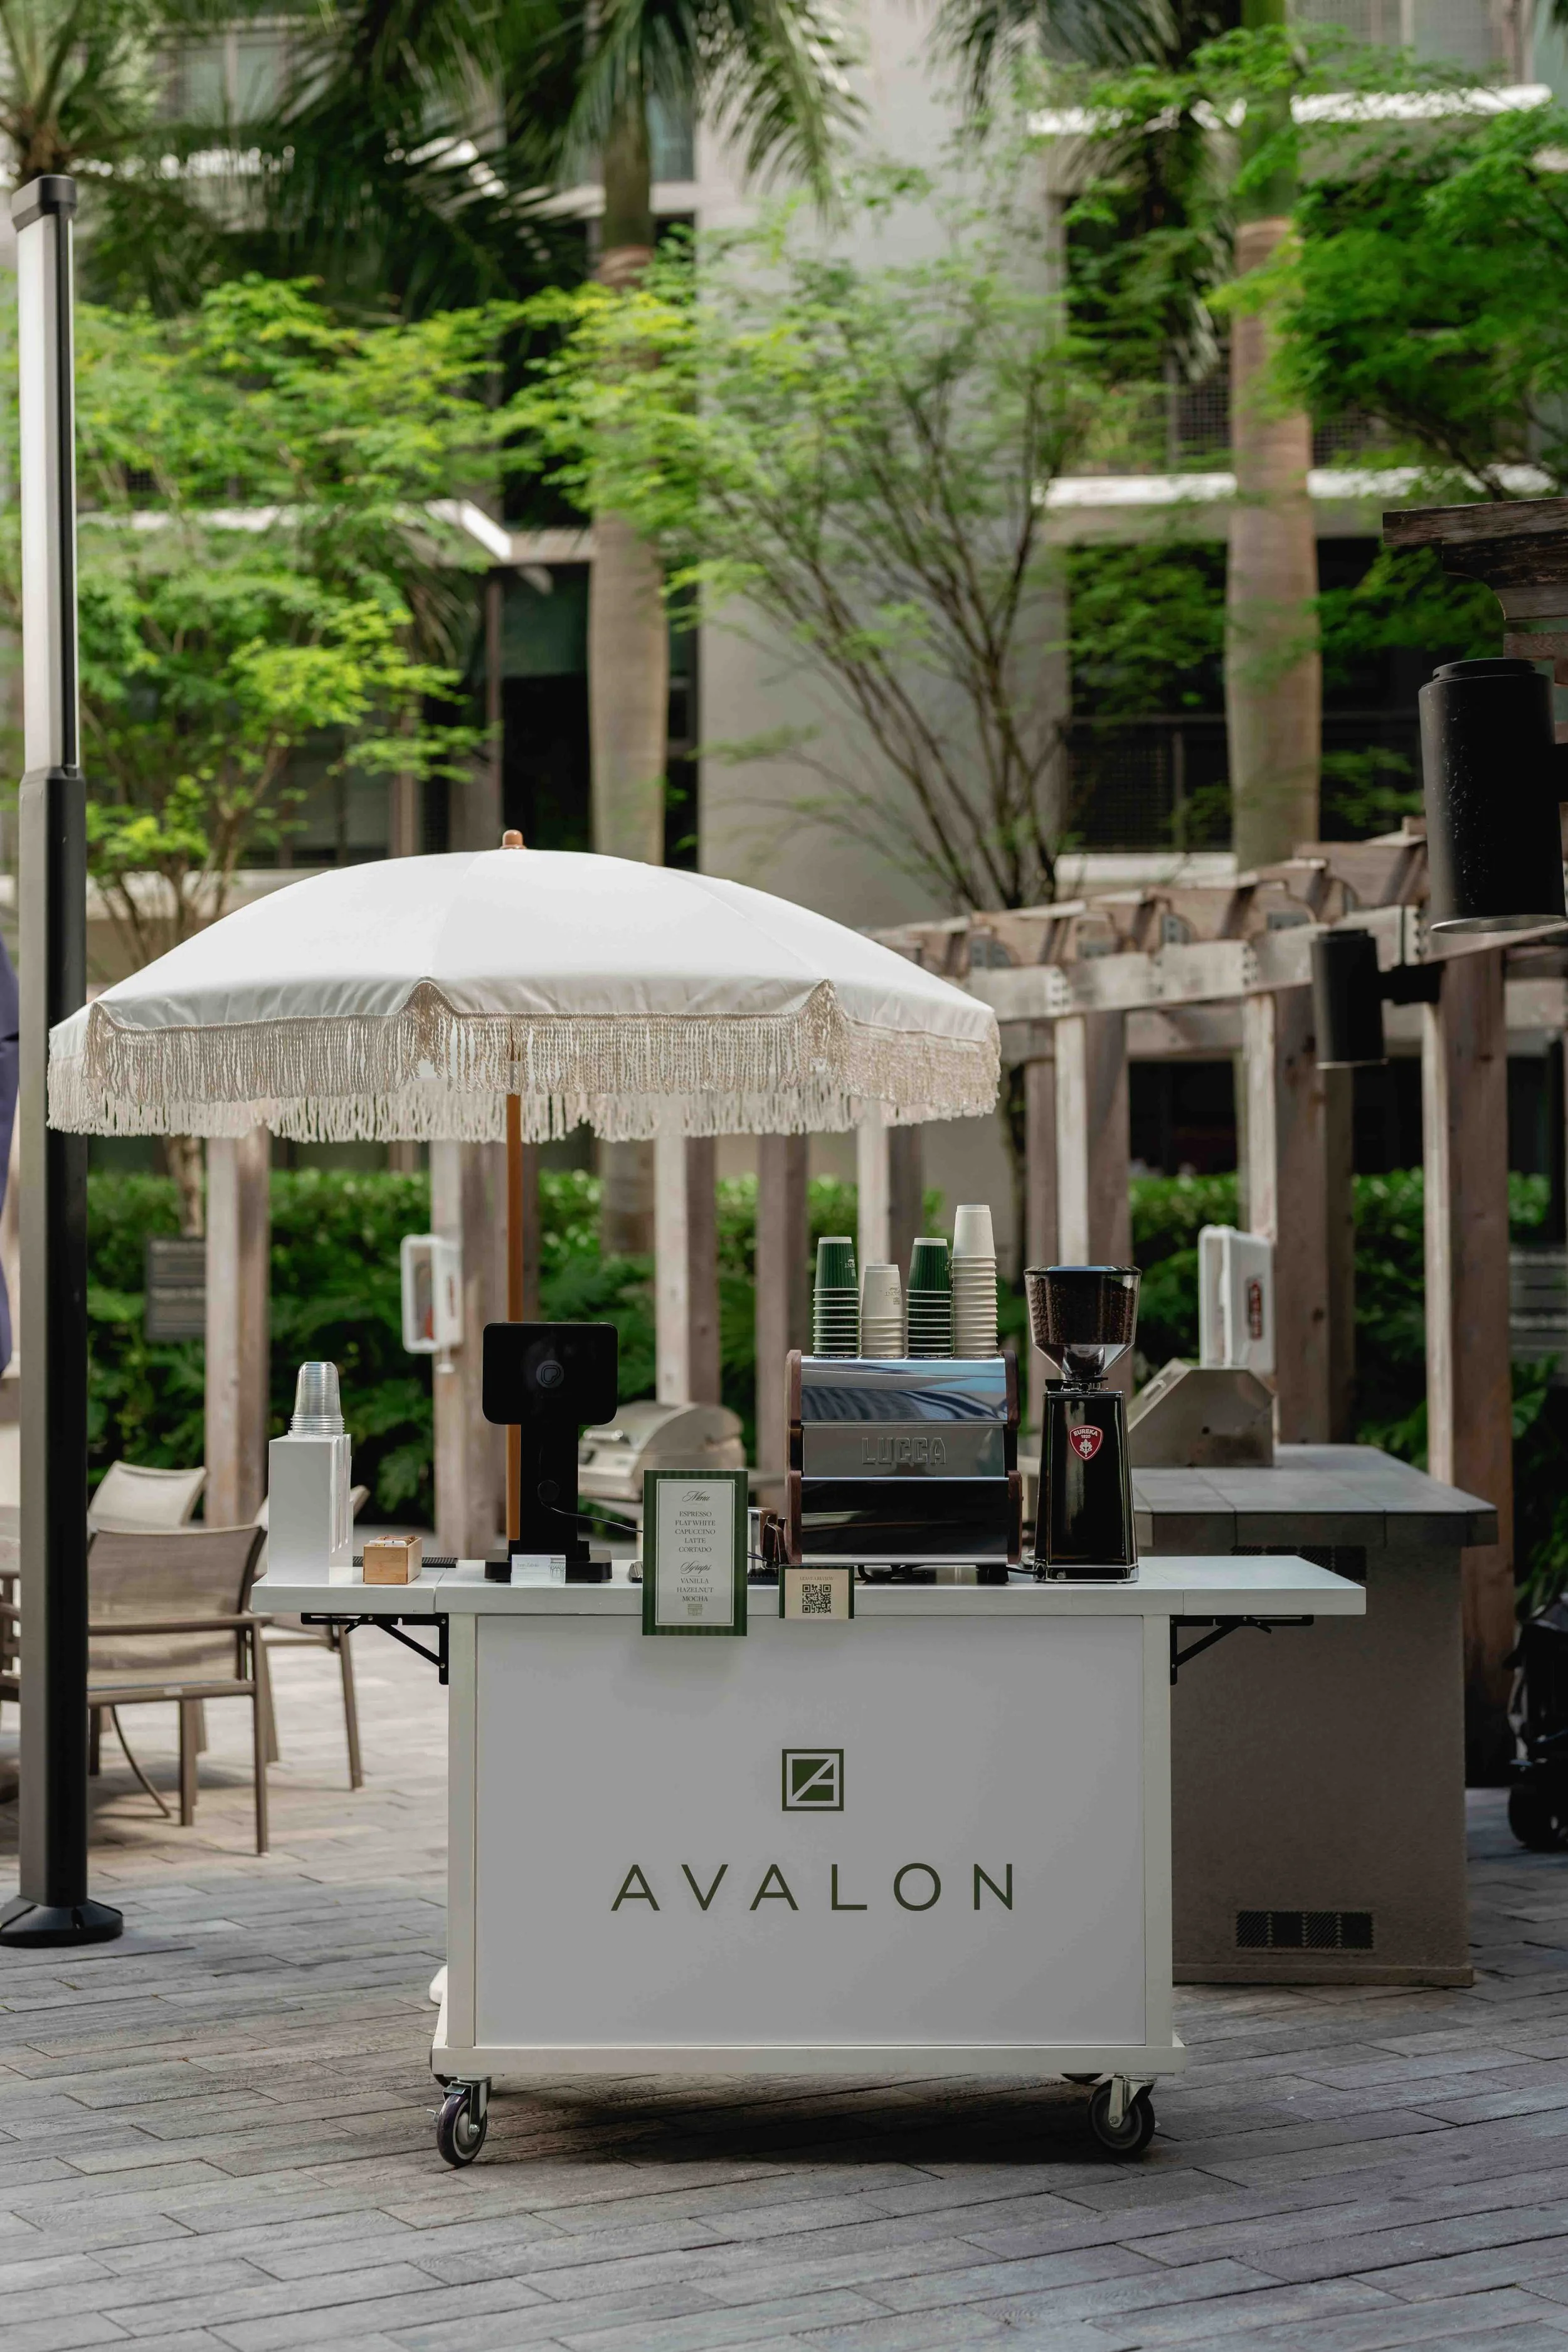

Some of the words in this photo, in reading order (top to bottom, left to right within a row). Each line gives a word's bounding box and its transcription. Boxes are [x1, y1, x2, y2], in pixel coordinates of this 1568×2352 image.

[861, 1437, 947, 1465] LUCCA
[682, 1490, 711, 1502] Menu
[680, 1560, 712, 1574] Syrups
[611, 1863, 1012, 1910] AVALON
